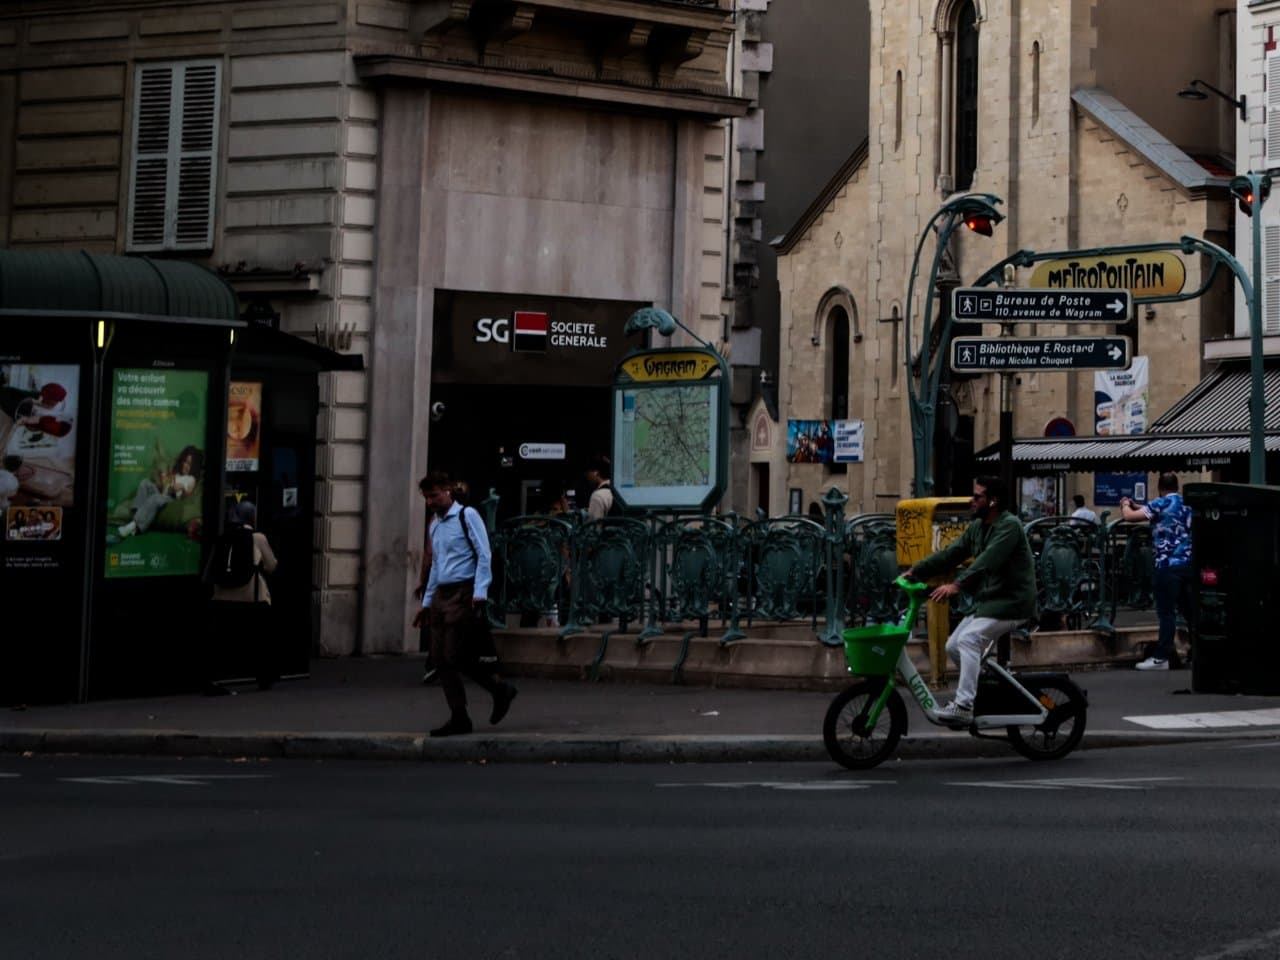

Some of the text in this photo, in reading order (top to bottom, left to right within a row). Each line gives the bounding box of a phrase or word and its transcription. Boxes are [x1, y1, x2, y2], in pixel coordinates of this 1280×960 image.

[995, 294, 1092, 306] Bureau de Poste
[1049, 307, 1061, 317] de
[1065, 307, 1102, 319] Wagram
[475, 318, 509, 343] SG
[551, 321, 596, 335] SOCIETE
[550, 335, 607, 348] GENERALE
[979, 343, 1040, 355] Bibliothèque
[990, 357, 1005, 365] Rue
[1008, 357, 1037, 365] Nicolas
[1040, 356, 1073, 366] Chuquet
[118, 373, 165, 383] Votre enfant
[129, 384, 166, 394] découvrir
[116, 396, 180, 408] des mots comme
[909, 673, 935, 710] Lime
